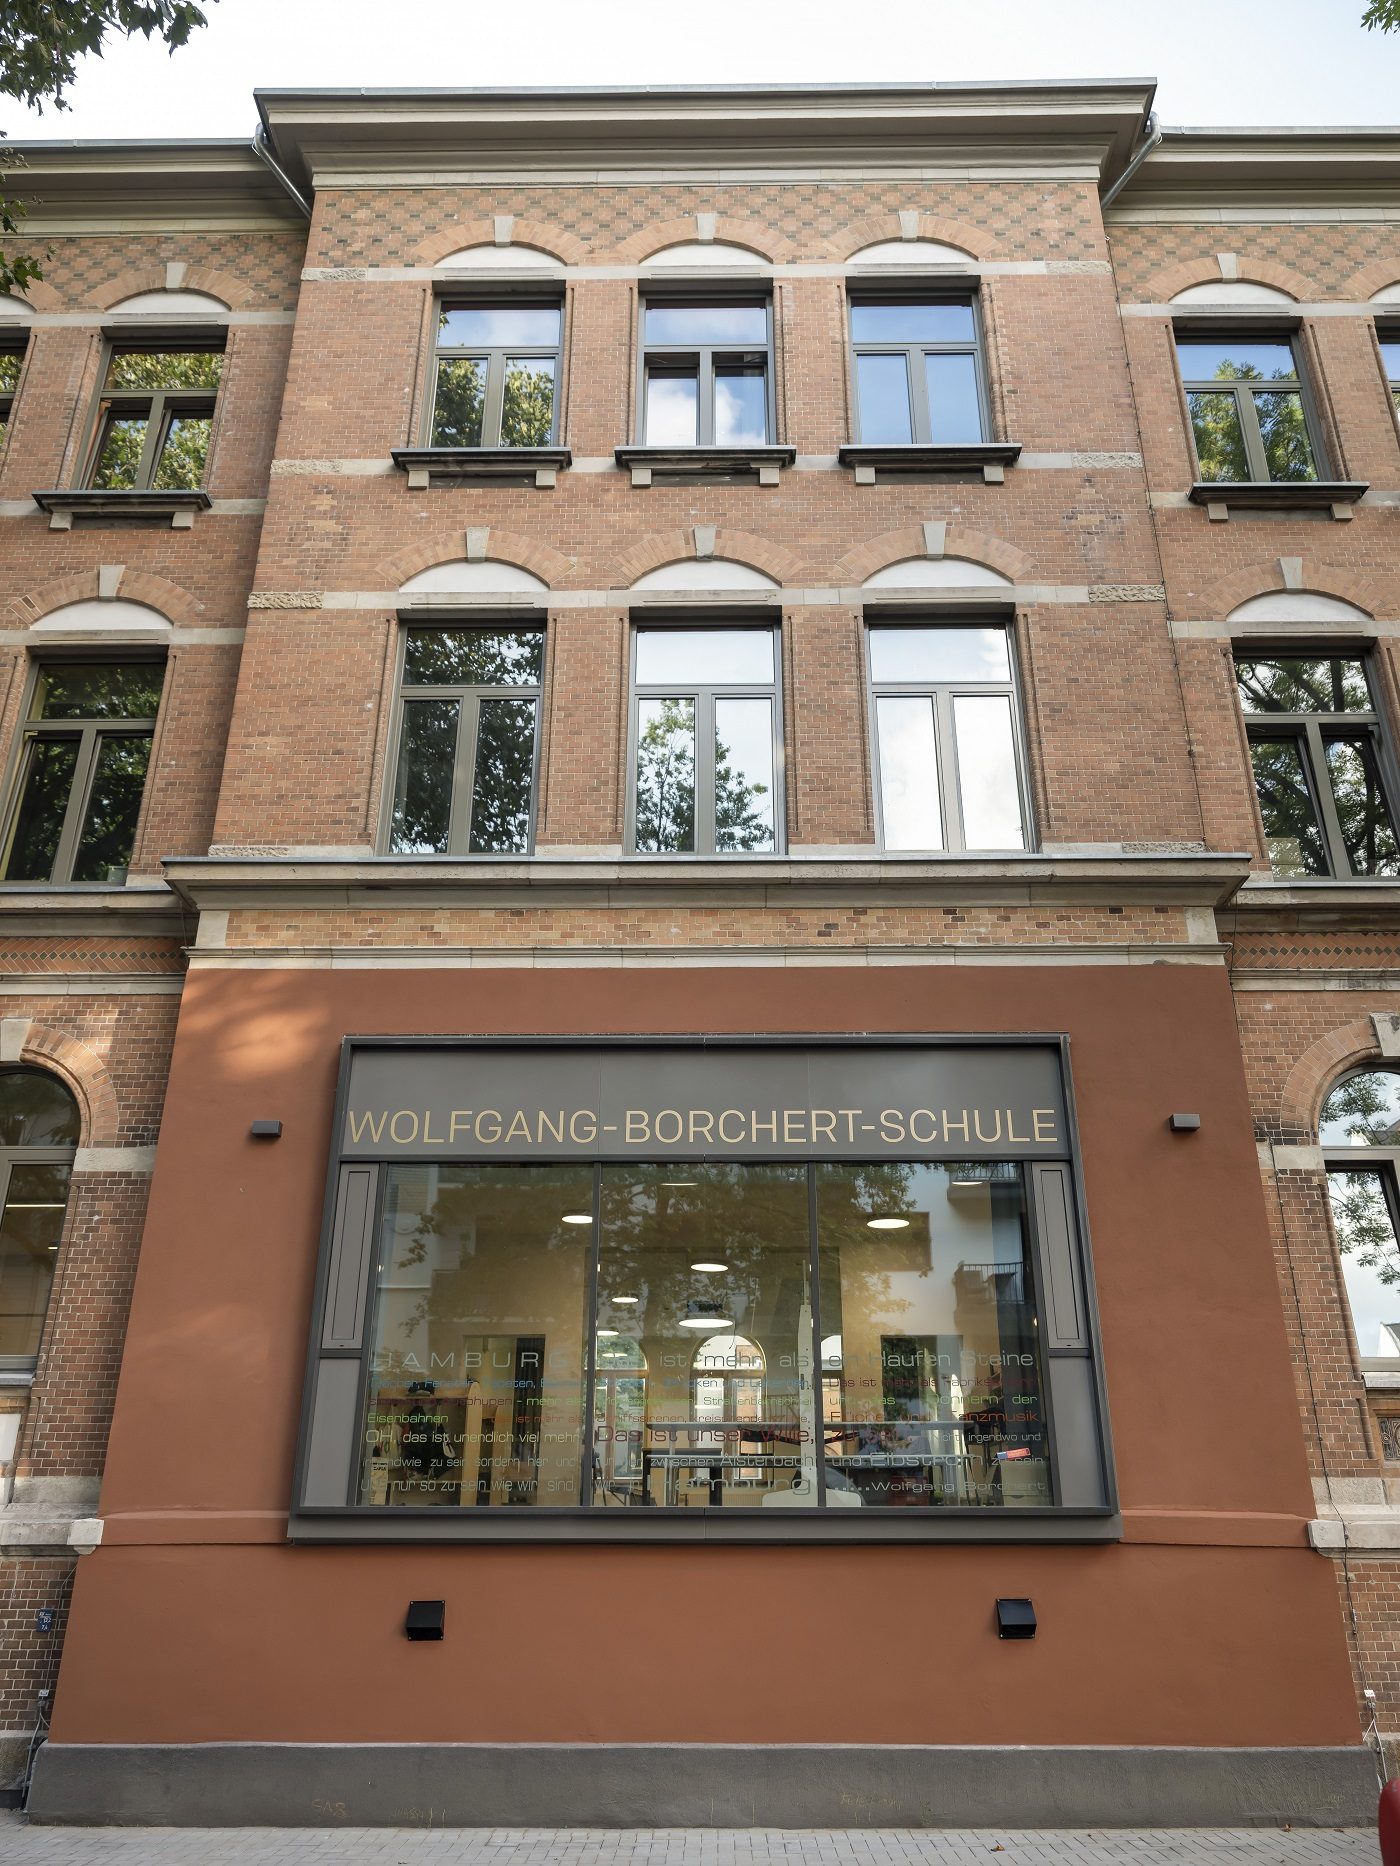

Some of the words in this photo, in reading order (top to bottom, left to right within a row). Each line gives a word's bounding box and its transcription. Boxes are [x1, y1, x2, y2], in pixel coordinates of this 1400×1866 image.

[349, 1110, 1058, 1143] WOLFGANG-BORCHERT-SCHULE
[373, 1351, 567, 1368] HAMBURG
[660, 1351, 687, 1367] ist
[704, 1351, 761, 1367] mehr
[779, 1351, 809, 1367] als
[870, 1350, 951, 1367] Haufen
[961, 1349, 1034, 1366] Steine
[860, 1378, 877, 1387] ist
[921, 1377, 937, 1387] als
[829, 1396, 856, 1405] un
[1012, 1394, 1037, 1405] der
[367, 1413, 448, 1423] Eisenbahnen
[597, 1413, 687, 1424] Shiffssirenen,
[403, 1432, 427, 1442] das
[432, 1432, 449, 1442] ist
[454, 1432, 514, 1443] unendlich
[519, 1432, 539, 1442] viel
[597, 1425, 640, 1442] Das
[650, 1427, 677, 1442] ist
[688, 1428, 752, 1442] unser
[968, 1432, 1018, 1443] irgendwo
[1021, 1432, 1042, 1441] und
[362, 1456, 422, 1468] irndwie
[430, 1459, 443, 1467] zu
[720, 1452, 815, 1467] Alsterbach
[832, 1455, 862, 1467] und
[870, 1452, 983, 1467] Elbstrom
[393, 1480, 415, 1492] nur
[441, 1480, 456, 1491] zu
[492, 1478, 513, 1491] wie
[518, 1478, 538, 1491] wir
